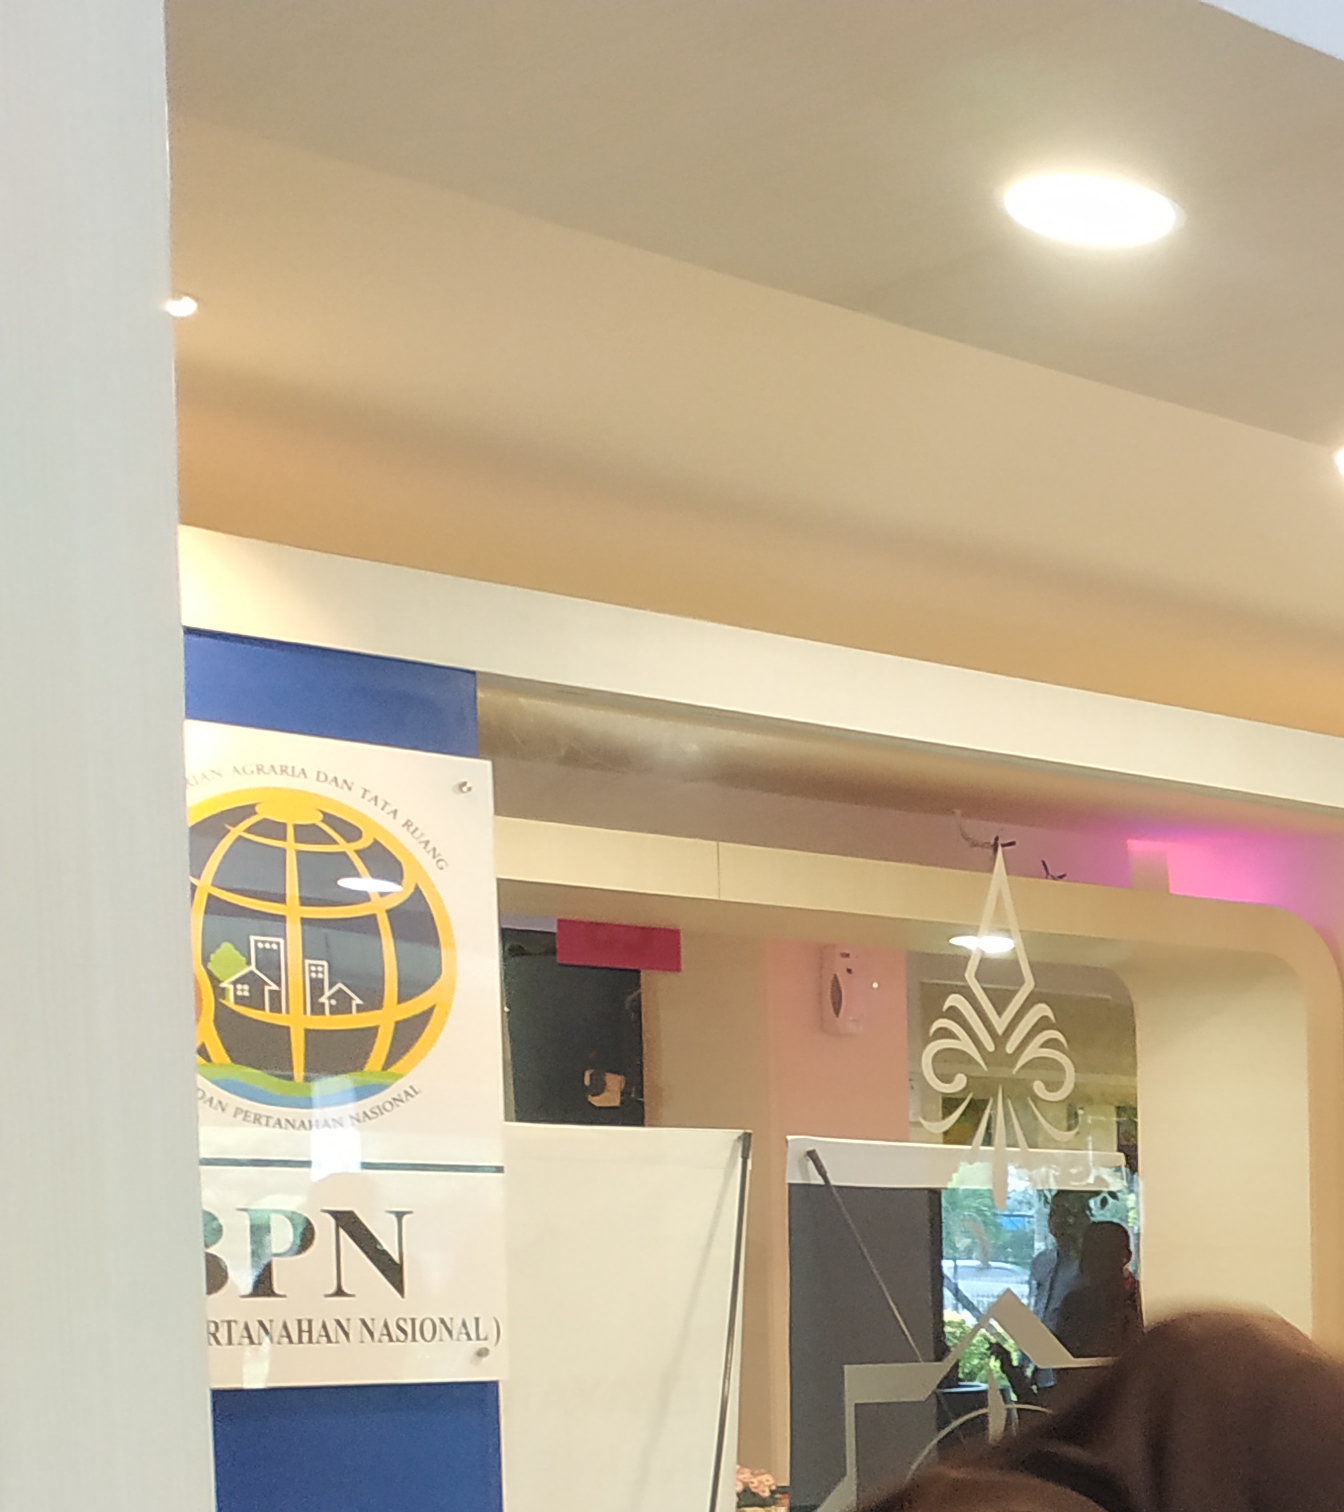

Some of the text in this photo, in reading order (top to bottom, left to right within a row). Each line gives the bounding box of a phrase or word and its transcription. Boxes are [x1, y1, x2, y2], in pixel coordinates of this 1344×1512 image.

[230, 763, 308, 780] AGRARIA
[315, 769, 355, 792] DAN
[360, 786, 399, 821] TATA
[401, 817, 449, 872] RUANG
[231, 1107, 345, 1132] PERTANAHAN
[349, 1083, 422, 1124] NASIONAL
